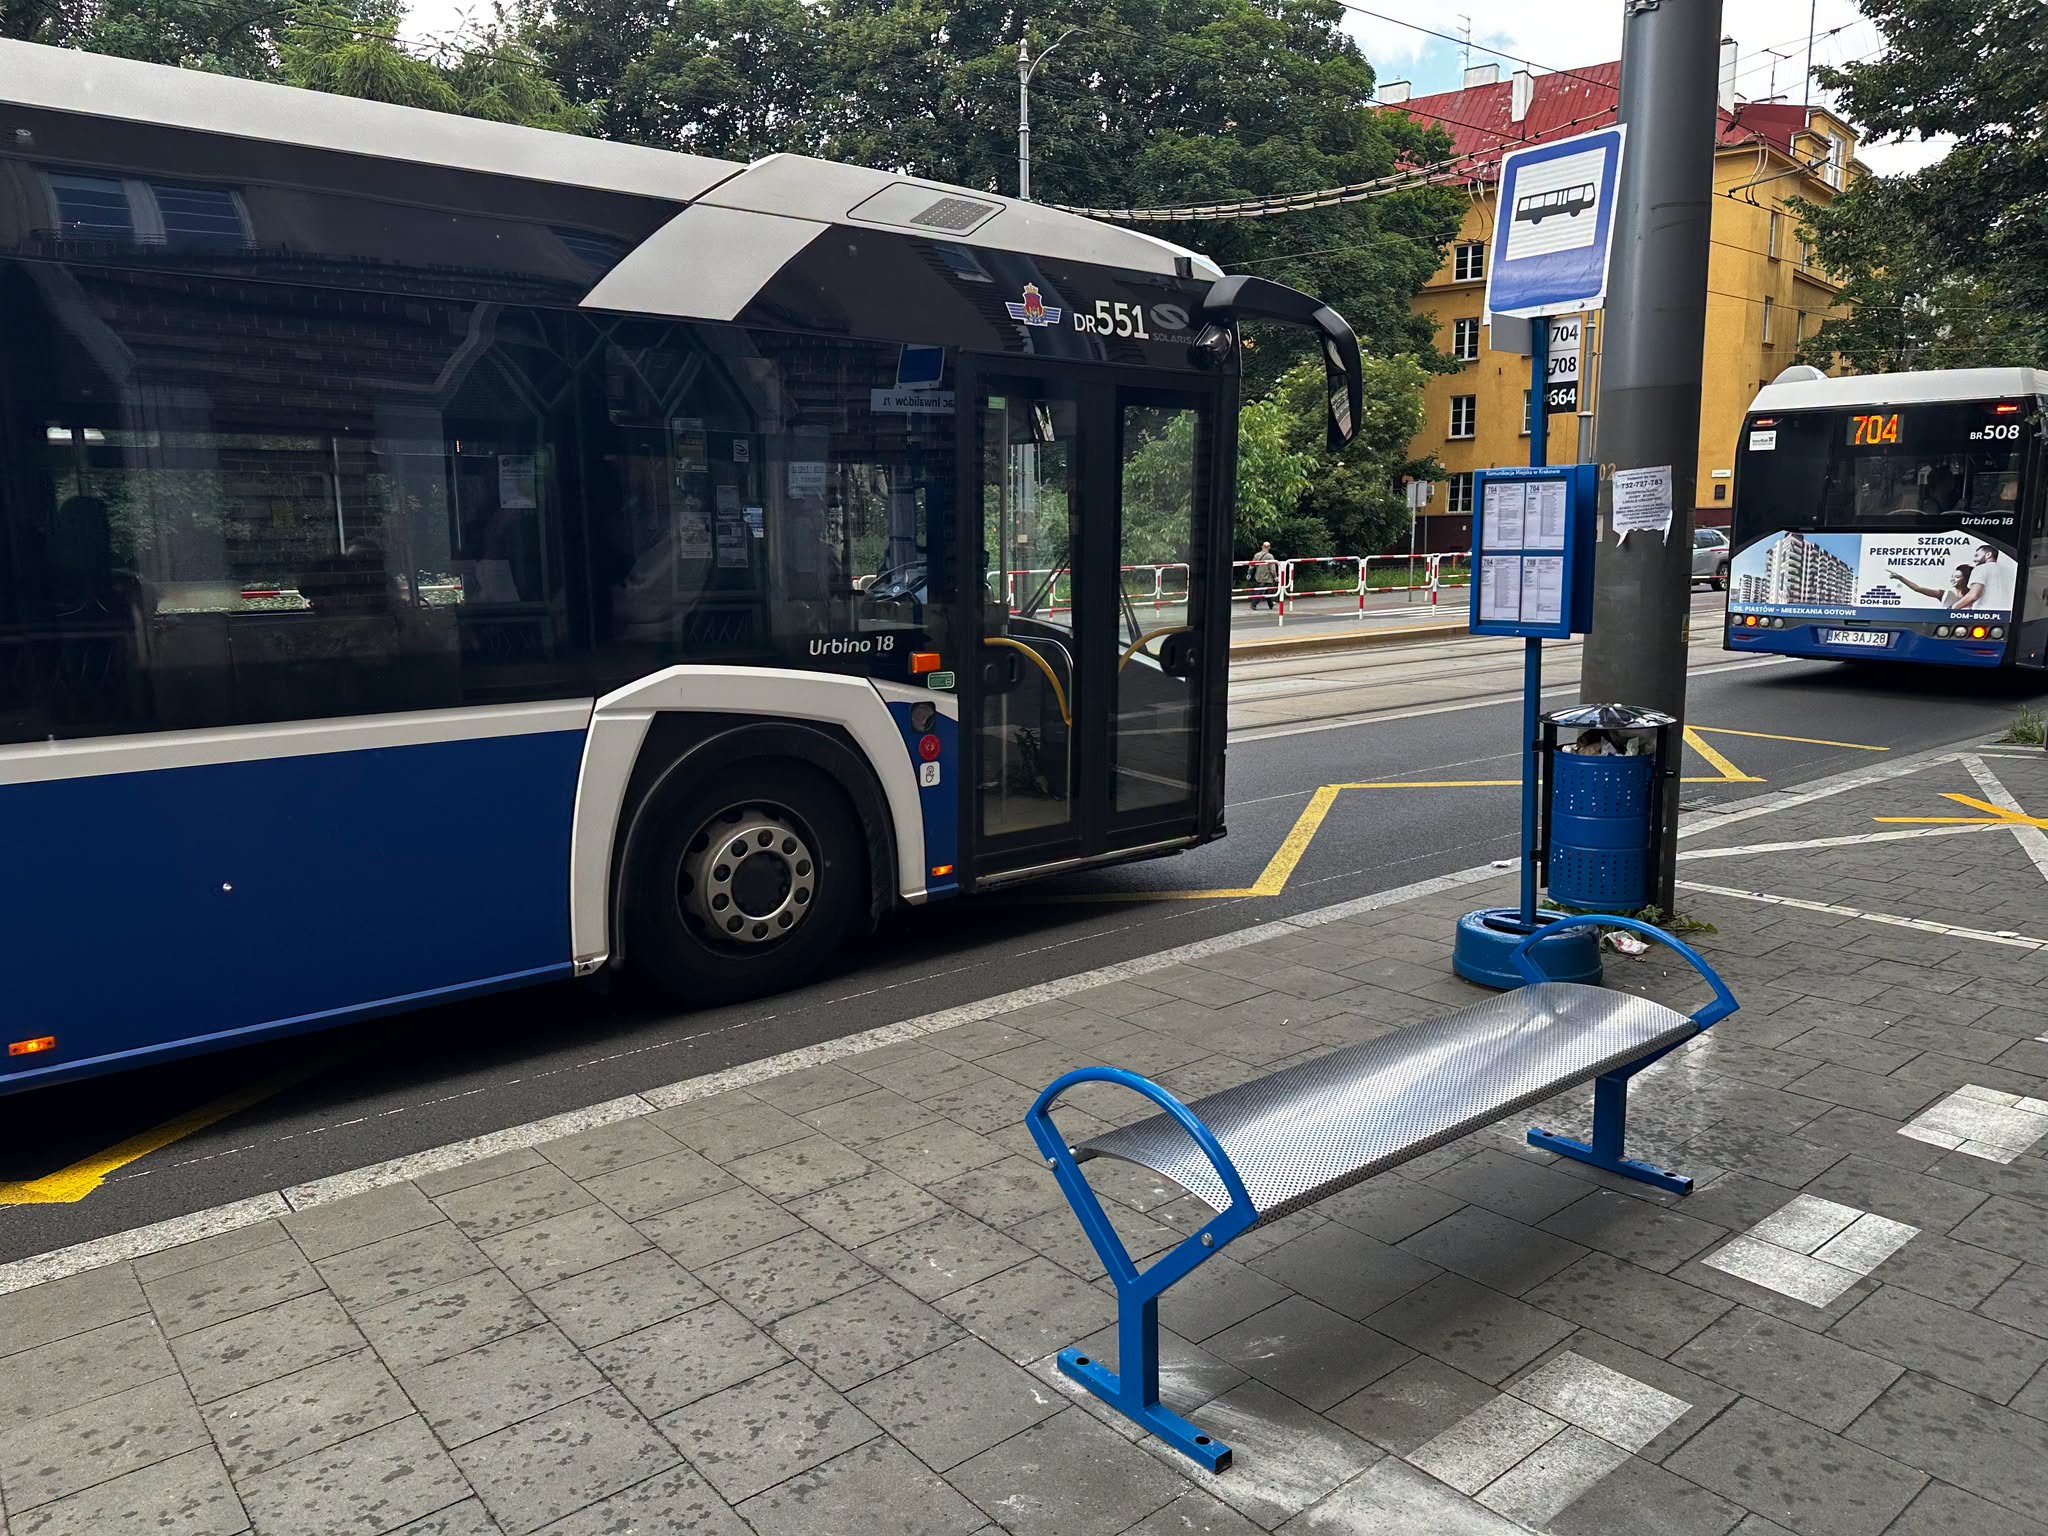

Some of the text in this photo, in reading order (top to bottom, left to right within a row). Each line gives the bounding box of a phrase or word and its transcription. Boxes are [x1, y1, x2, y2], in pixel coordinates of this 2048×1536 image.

[1552, 324, 1578, 342] 704
[1152, 332, 1194, 345] SOLARIS
[1551, 356, 1577, 373] 708
[1550, 388, 1576, 406] 664
[1853, 414, 1898, 444] 704
[1529, 485, 1539, 493] 704
[1621, 479, 1663, 489] 732-727-783
[1487, 486, 1497, 495] 704
[1961, 517, 2014, 525] Urbino 18
[1918, 537, 1970, 545] SZEROKA
[1870, 547, 1951, 556] PERSPEKTYWA
[1888, 556, 1945, 566] MIESZKAŃ
[1950, 612, 2001, 620] DOM-BUD.PL
[1834, 631, 1886, 644] KR 3AJ28
[809, 635, 894, 656] Urbino 18
